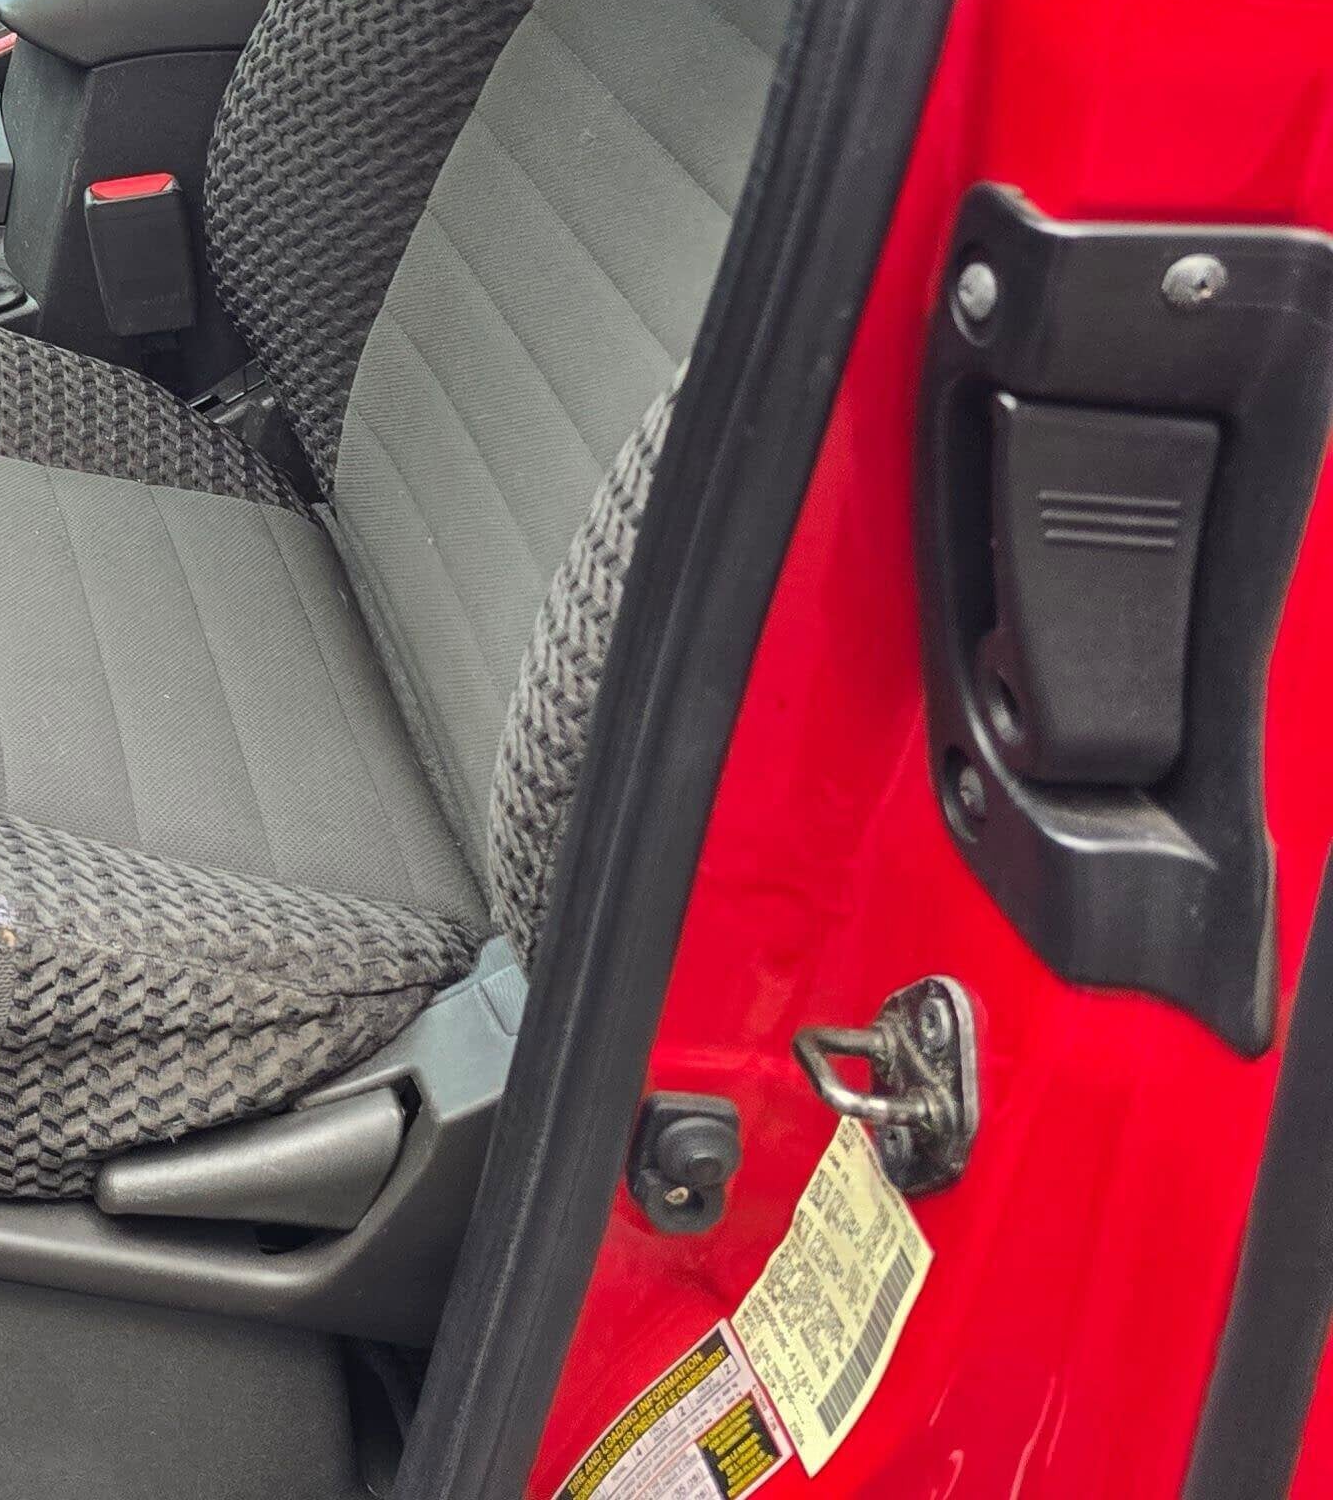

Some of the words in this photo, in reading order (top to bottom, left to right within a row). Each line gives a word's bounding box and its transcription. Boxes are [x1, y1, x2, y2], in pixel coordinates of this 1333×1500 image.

[568, 1468, 587, 1495] TIRE
[584, 1451, 602, 1475] AND
[600, 1410, 639, 1455] LOADING
[637, 1350, 704, 1415] INFORMATION
[655, 1399, 668, 1414] ET
[666, 1389, 679, 1407] LE
[676, 1345, 726, 1397] CHARGEMENT
